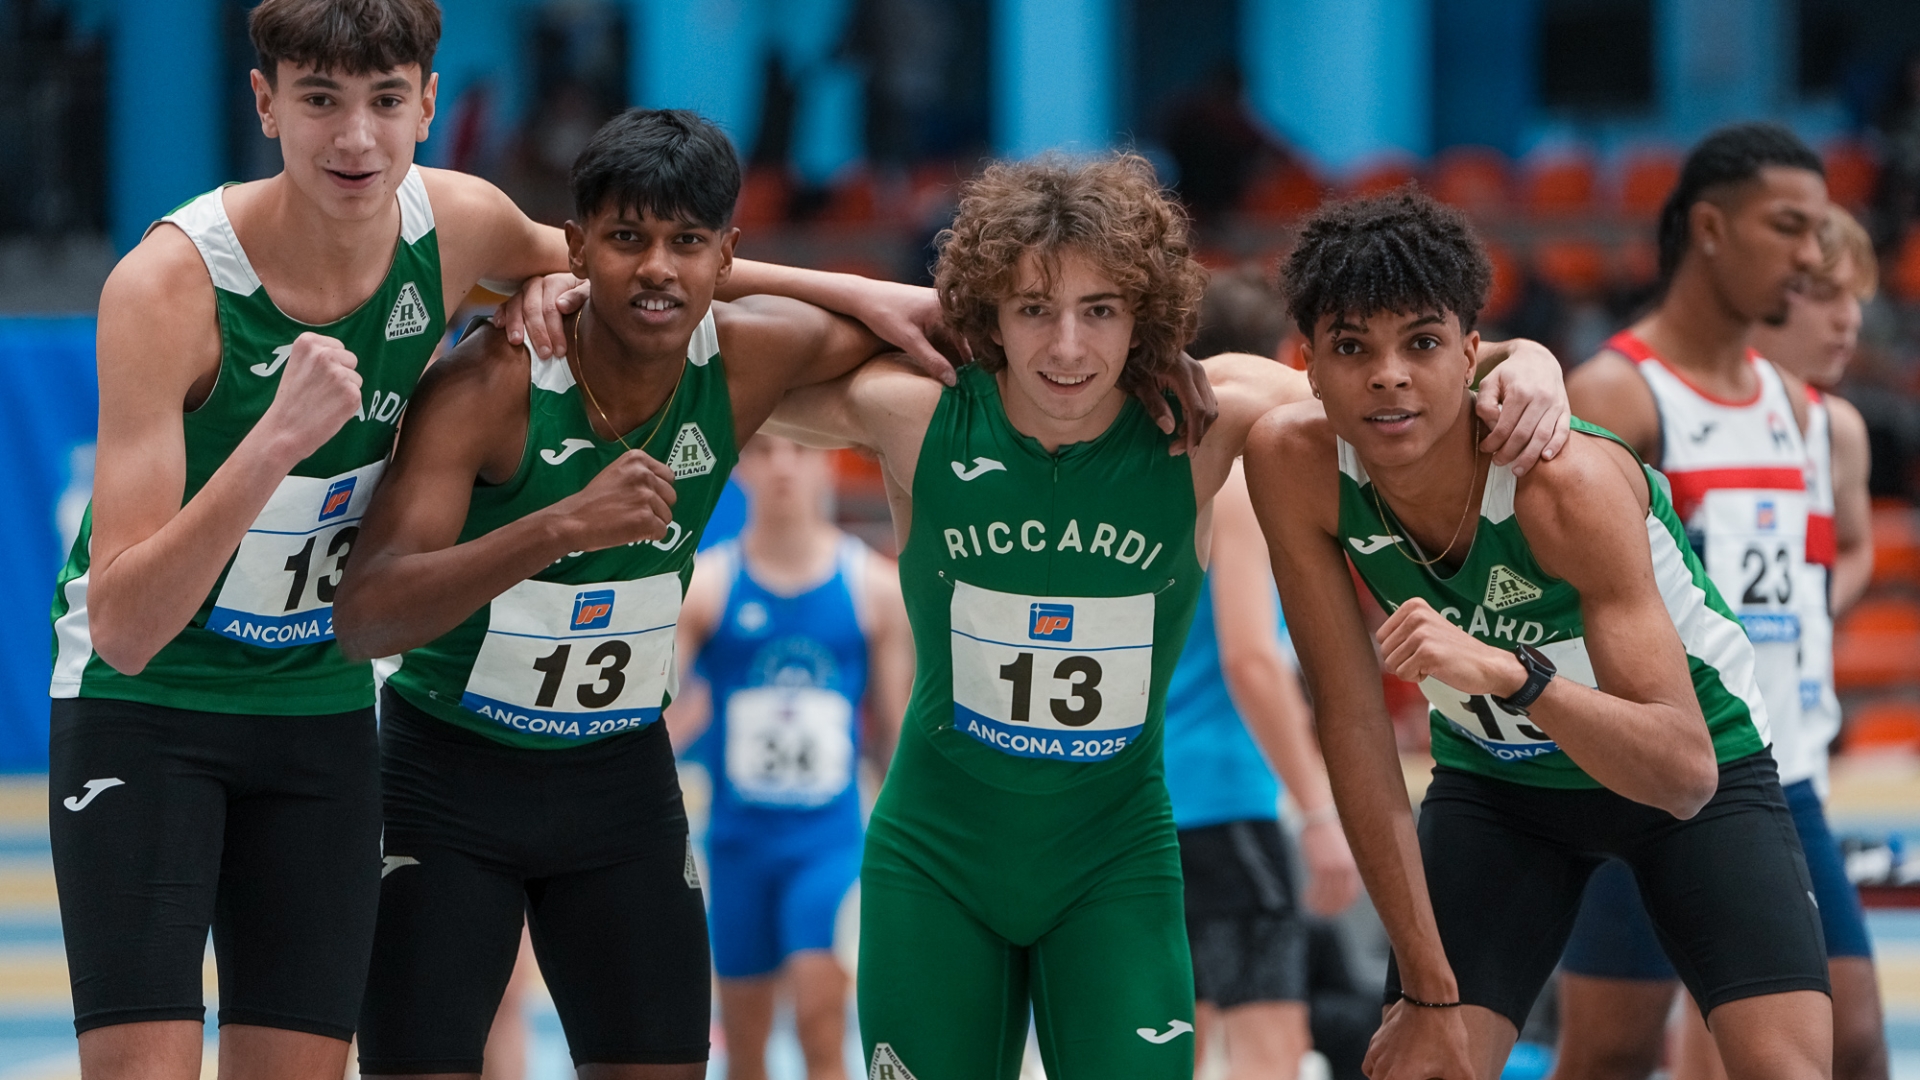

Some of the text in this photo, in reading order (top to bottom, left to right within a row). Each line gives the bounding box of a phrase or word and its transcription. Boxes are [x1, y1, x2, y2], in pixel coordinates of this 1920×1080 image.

[388, 288, 407, 328] ATLETICA
[400, 303, 414, 321] R
[408, 285, 427, 320] RICCARDI
[389, 325, 422, 337] MILANO
[396, 320, 417, 328] 1946
[681, 444, 698, 462] R
[690, 427, 712, 460] RICCARDI
[677, 461, 701, 469] 1946
[944, 519, 1162, 570] RICCARDI
[284, 526, 359, 612] 13
[1501, 567, 1537, 590] RICCARDI
[1487, 570, 1499, 602] ATLETICA
[1498, 579, 1520, 595] R
[1499, 590, 1527, 601] 1946
[1495, 593, 1536, 609] MILANO
[223, 619, 320, 643] ANCONA
[533, 640, 632, 709] 13
[999, 652, 1103, 727] 13
[477, 705, 642, 736] ANCONA 2025
[967, 720, 1127, 757] ANCONA 2025
